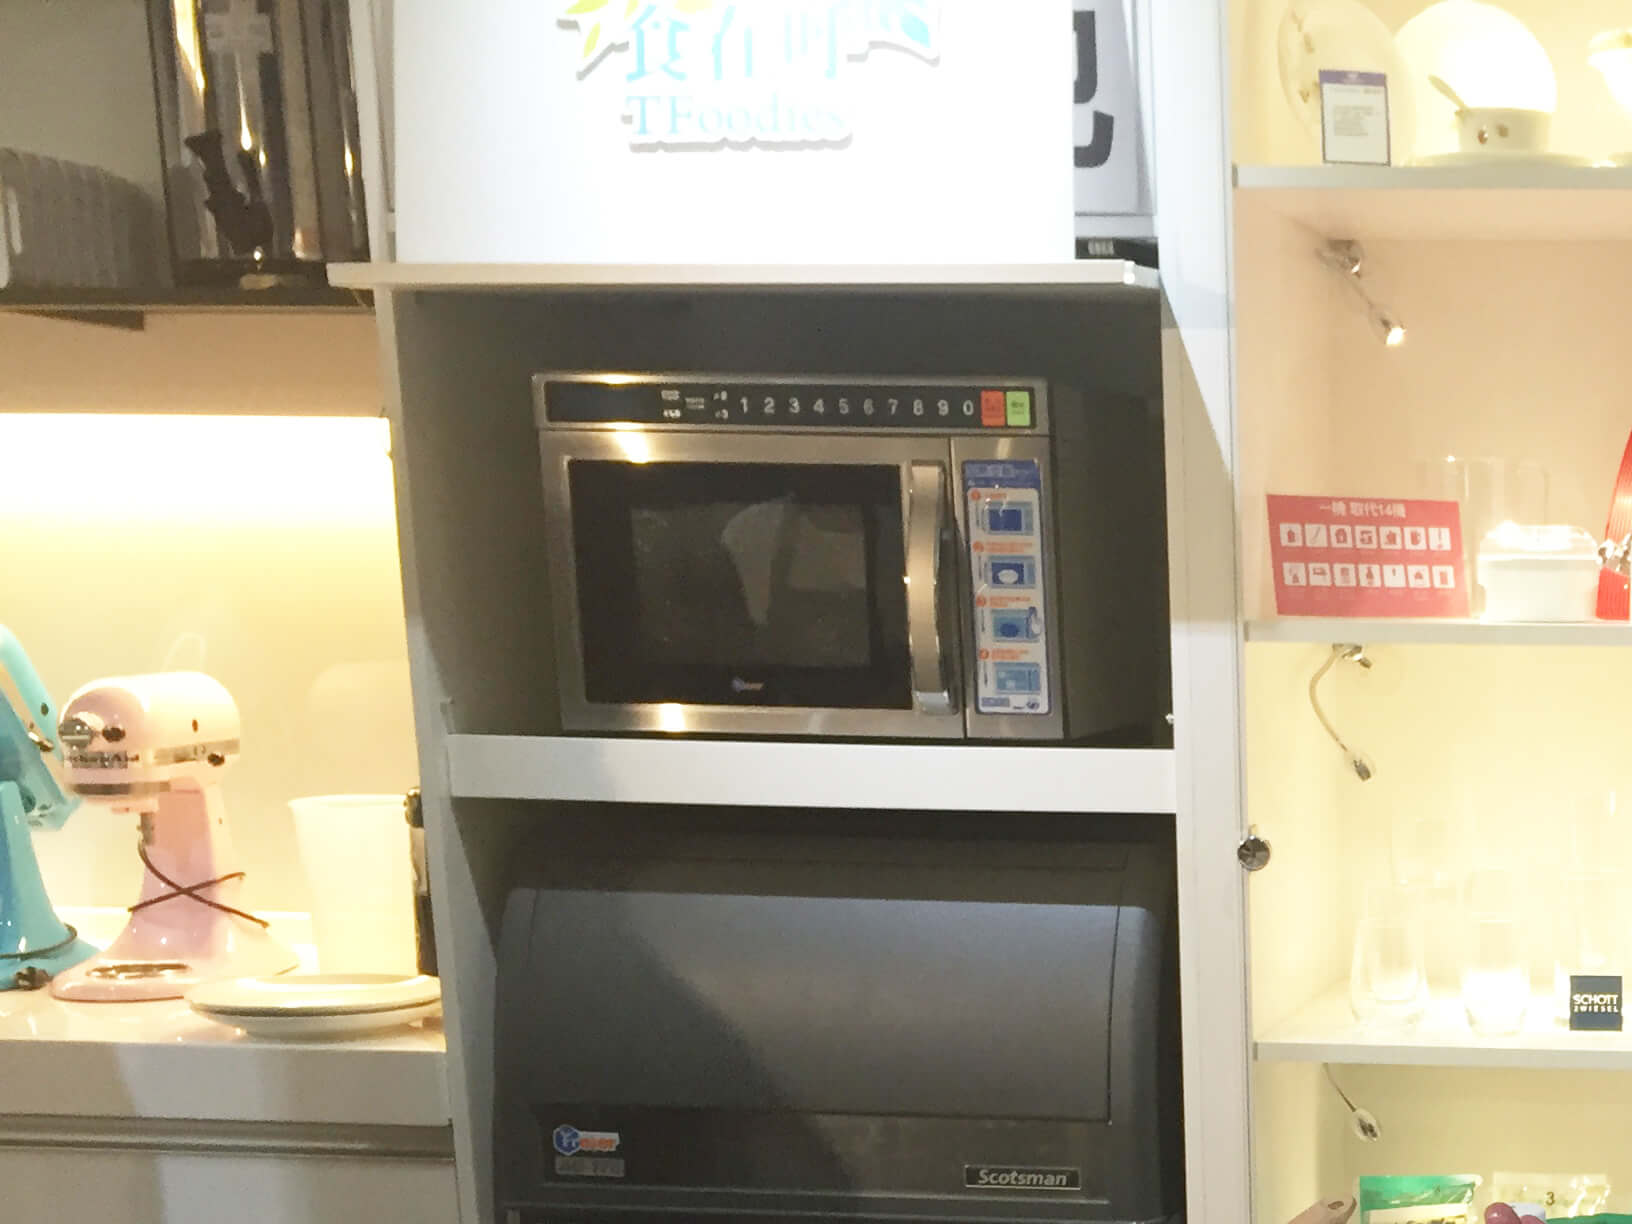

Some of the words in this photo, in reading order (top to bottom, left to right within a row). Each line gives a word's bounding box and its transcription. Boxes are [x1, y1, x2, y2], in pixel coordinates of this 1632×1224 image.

[626, 92, 846, 137] TFoodies
[740, 397, 749, 413] 1
[764, 397, 775, 414] 2
[789, 398, 800, 414] 3
[813, 399, 825, 415] 4
[838, 398, 849, 415] 5
[863, 399, 874, 416] 6
[887, 399, 899, 415] 7
[912, 399, 924, 416] 8
[937, 399, 949, 416] 9
[962, 399, 974, 416] 0
[1573, 993, 1619, 1005] SCHOTT
[978, 1168, 1067, 1186] Scotsman
[1545, 1191, 1555, 1206] 3
